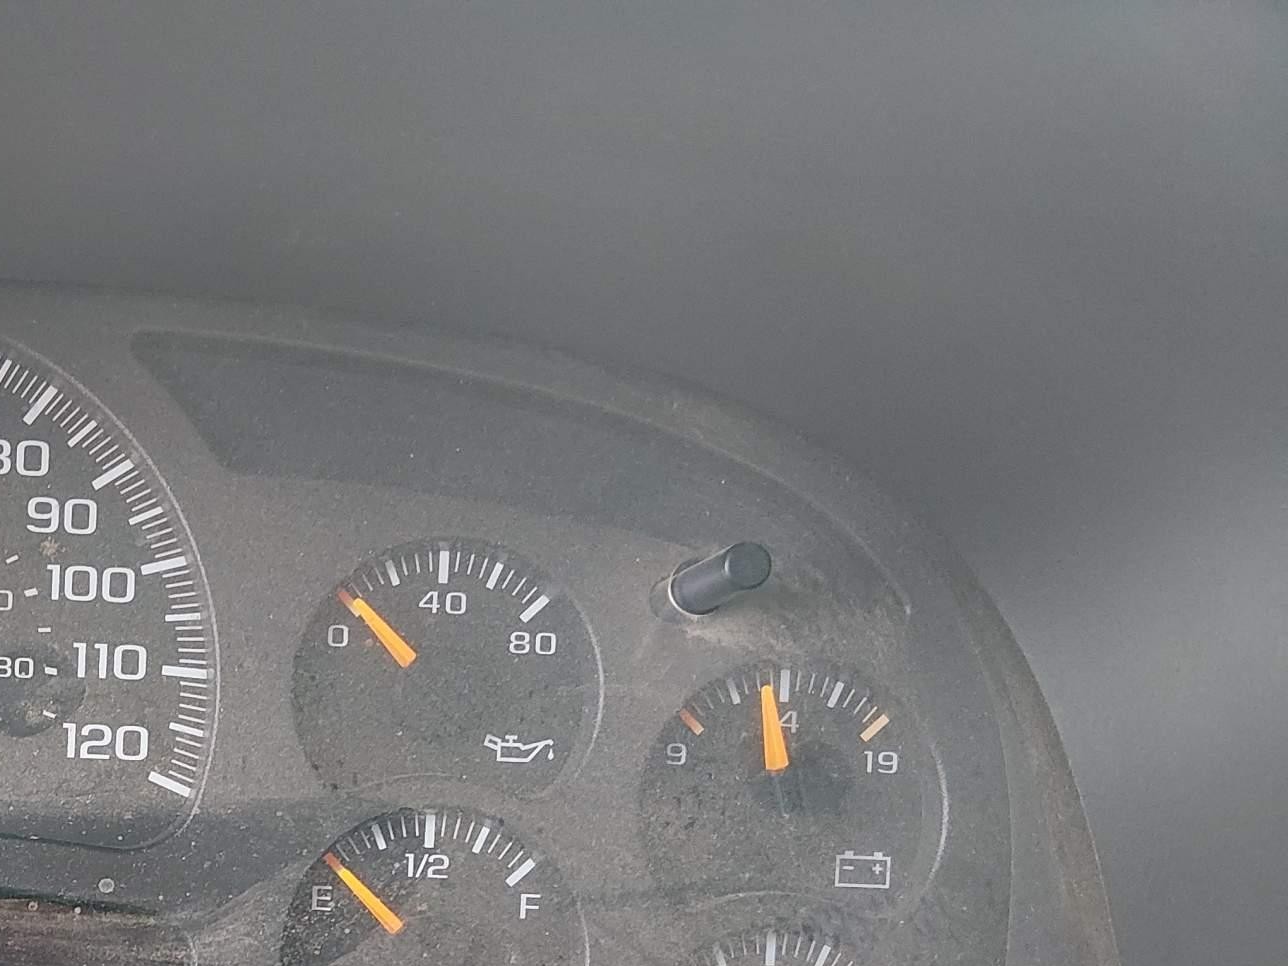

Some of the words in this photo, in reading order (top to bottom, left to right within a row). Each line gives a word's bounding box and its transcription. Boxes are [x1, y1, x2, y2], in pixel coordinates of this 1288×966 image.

[27, 497, 97, 534] 90
[47, 565, 135, 602] 100
[419, 591, 466, 614] 40
[328, 625, 348, 646] 0
[510, 632, 556, 654] 80
[74, 643, 146, 679] 110
[63, 723, 148, 760] 120
[667, 744, 686, 765] 9
[864, 751, 897, 773] 19
[405, 854, 449, 878] 1/2
[312, 886, 334, 912] E
[520, 894, 541, 919] F
